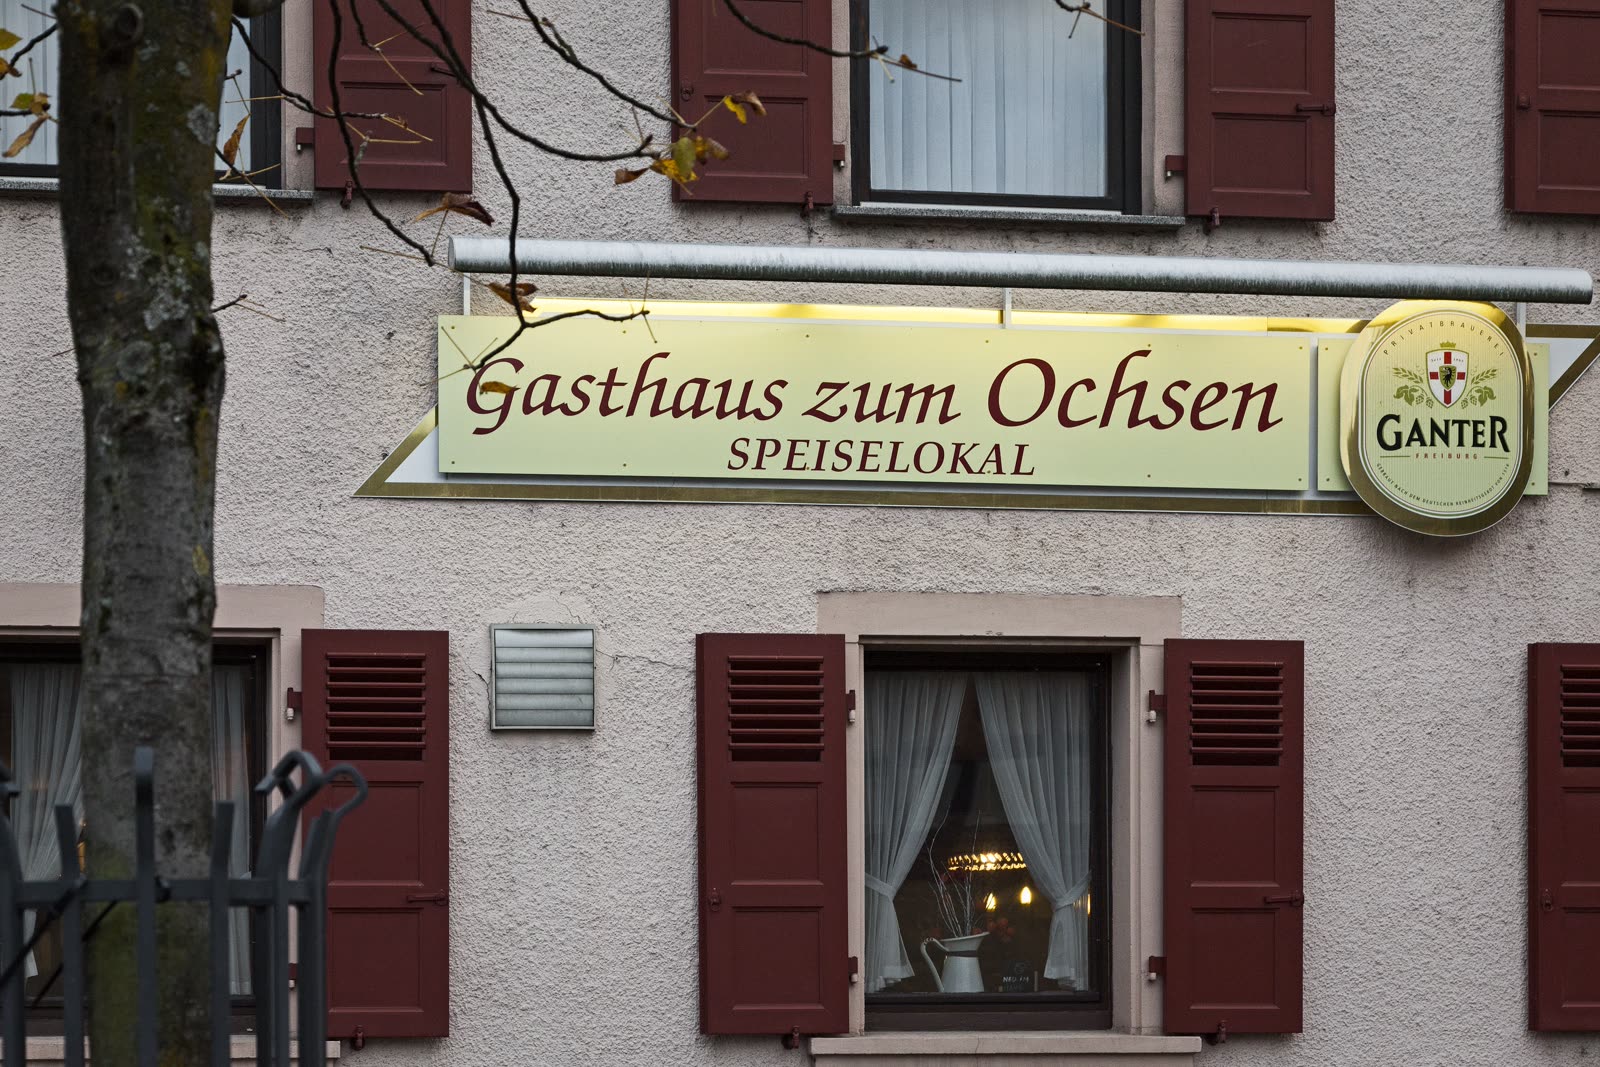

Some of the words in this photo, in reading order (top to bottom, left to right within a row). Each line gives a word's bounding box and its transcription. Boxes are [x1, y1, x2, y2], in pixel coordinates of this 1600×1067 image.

[1383, 320, 1504, 356] PRIVATBRAUEREI
[466, 351, 789, 435] Gasthaus
[802, 380, 962, 425] zum
[987, 350, 1284, 433] Ochsen
[1376, 413, 1511, 453] GANTER
[727, 437, 1036, 476] SPEISELOKAL
[1376, 463, 1394, 484] GEBRAUT
[1394, 484, 1408, 495] NACH
[1409, 493, 1420, 501] DEM
[1422, 498, 1453, 507] DEUTSCHEN
